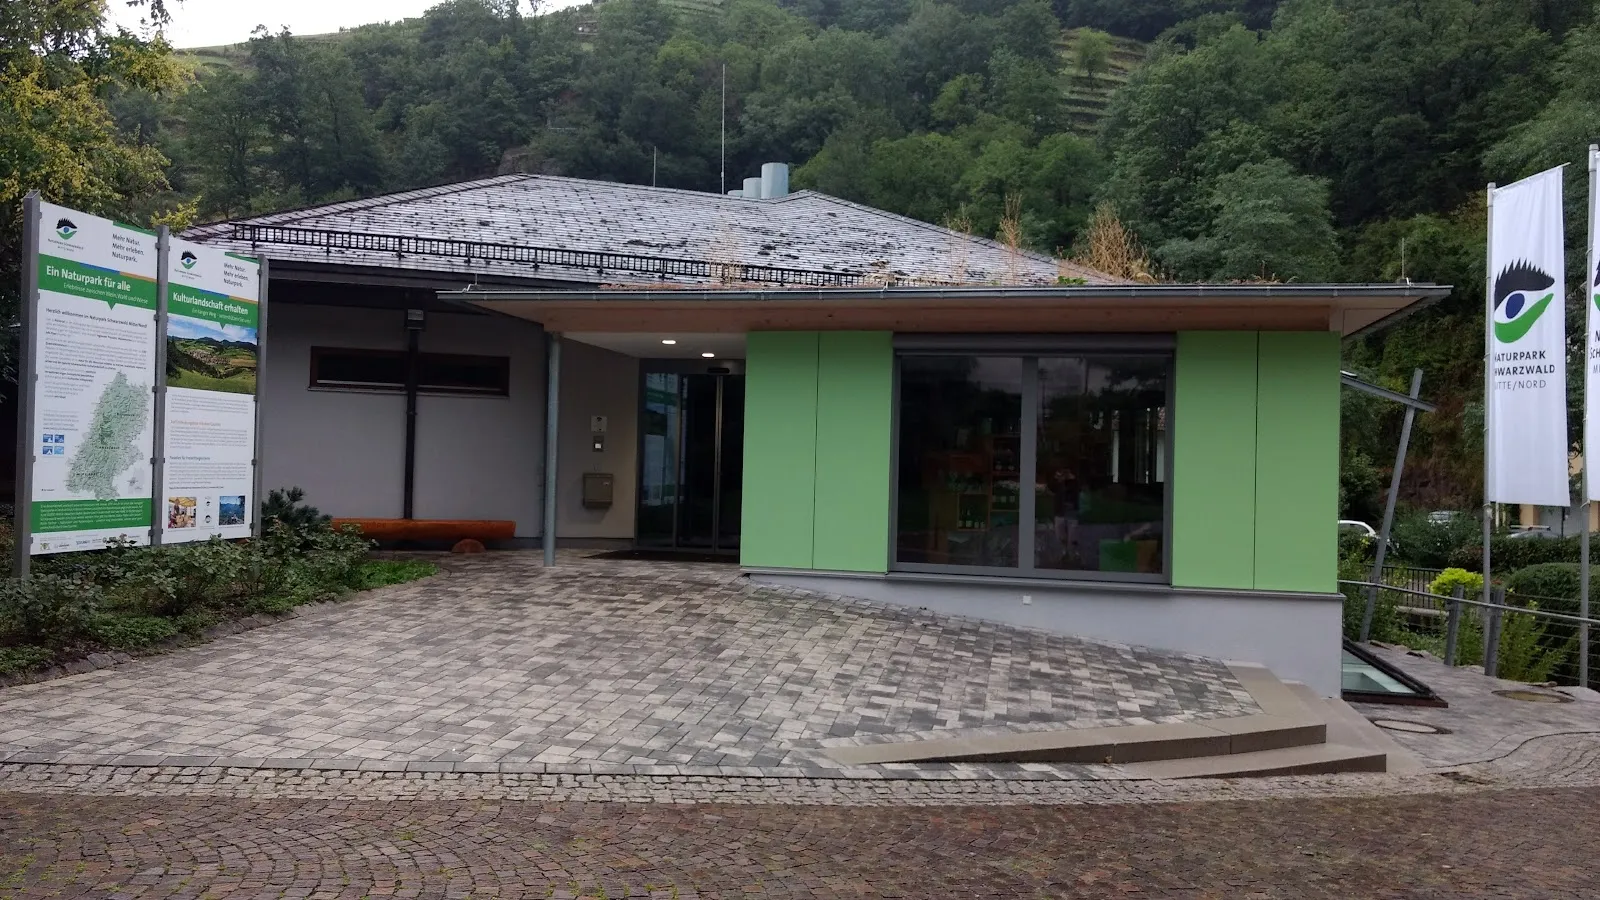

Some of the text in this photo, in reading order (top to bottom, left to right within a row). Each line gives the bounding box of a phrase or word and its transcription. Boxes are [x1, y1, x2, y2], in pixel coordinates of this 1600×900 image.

[112, 234, 140, 246] Mehr Natur.
[112, 243, 144, 256] Mehr erleben.
[112, 251, 137, 263] Naturpark.
[224, 262, 234, 270] Mehr
[46, 265, 131, 291] Ein Naturpark für alle
[224, 270, 234, 278] Mehr
[223, 278, 243, 287] Naturpark.
[173, 292, 248, 315] Kulturlandschaft erhalten
